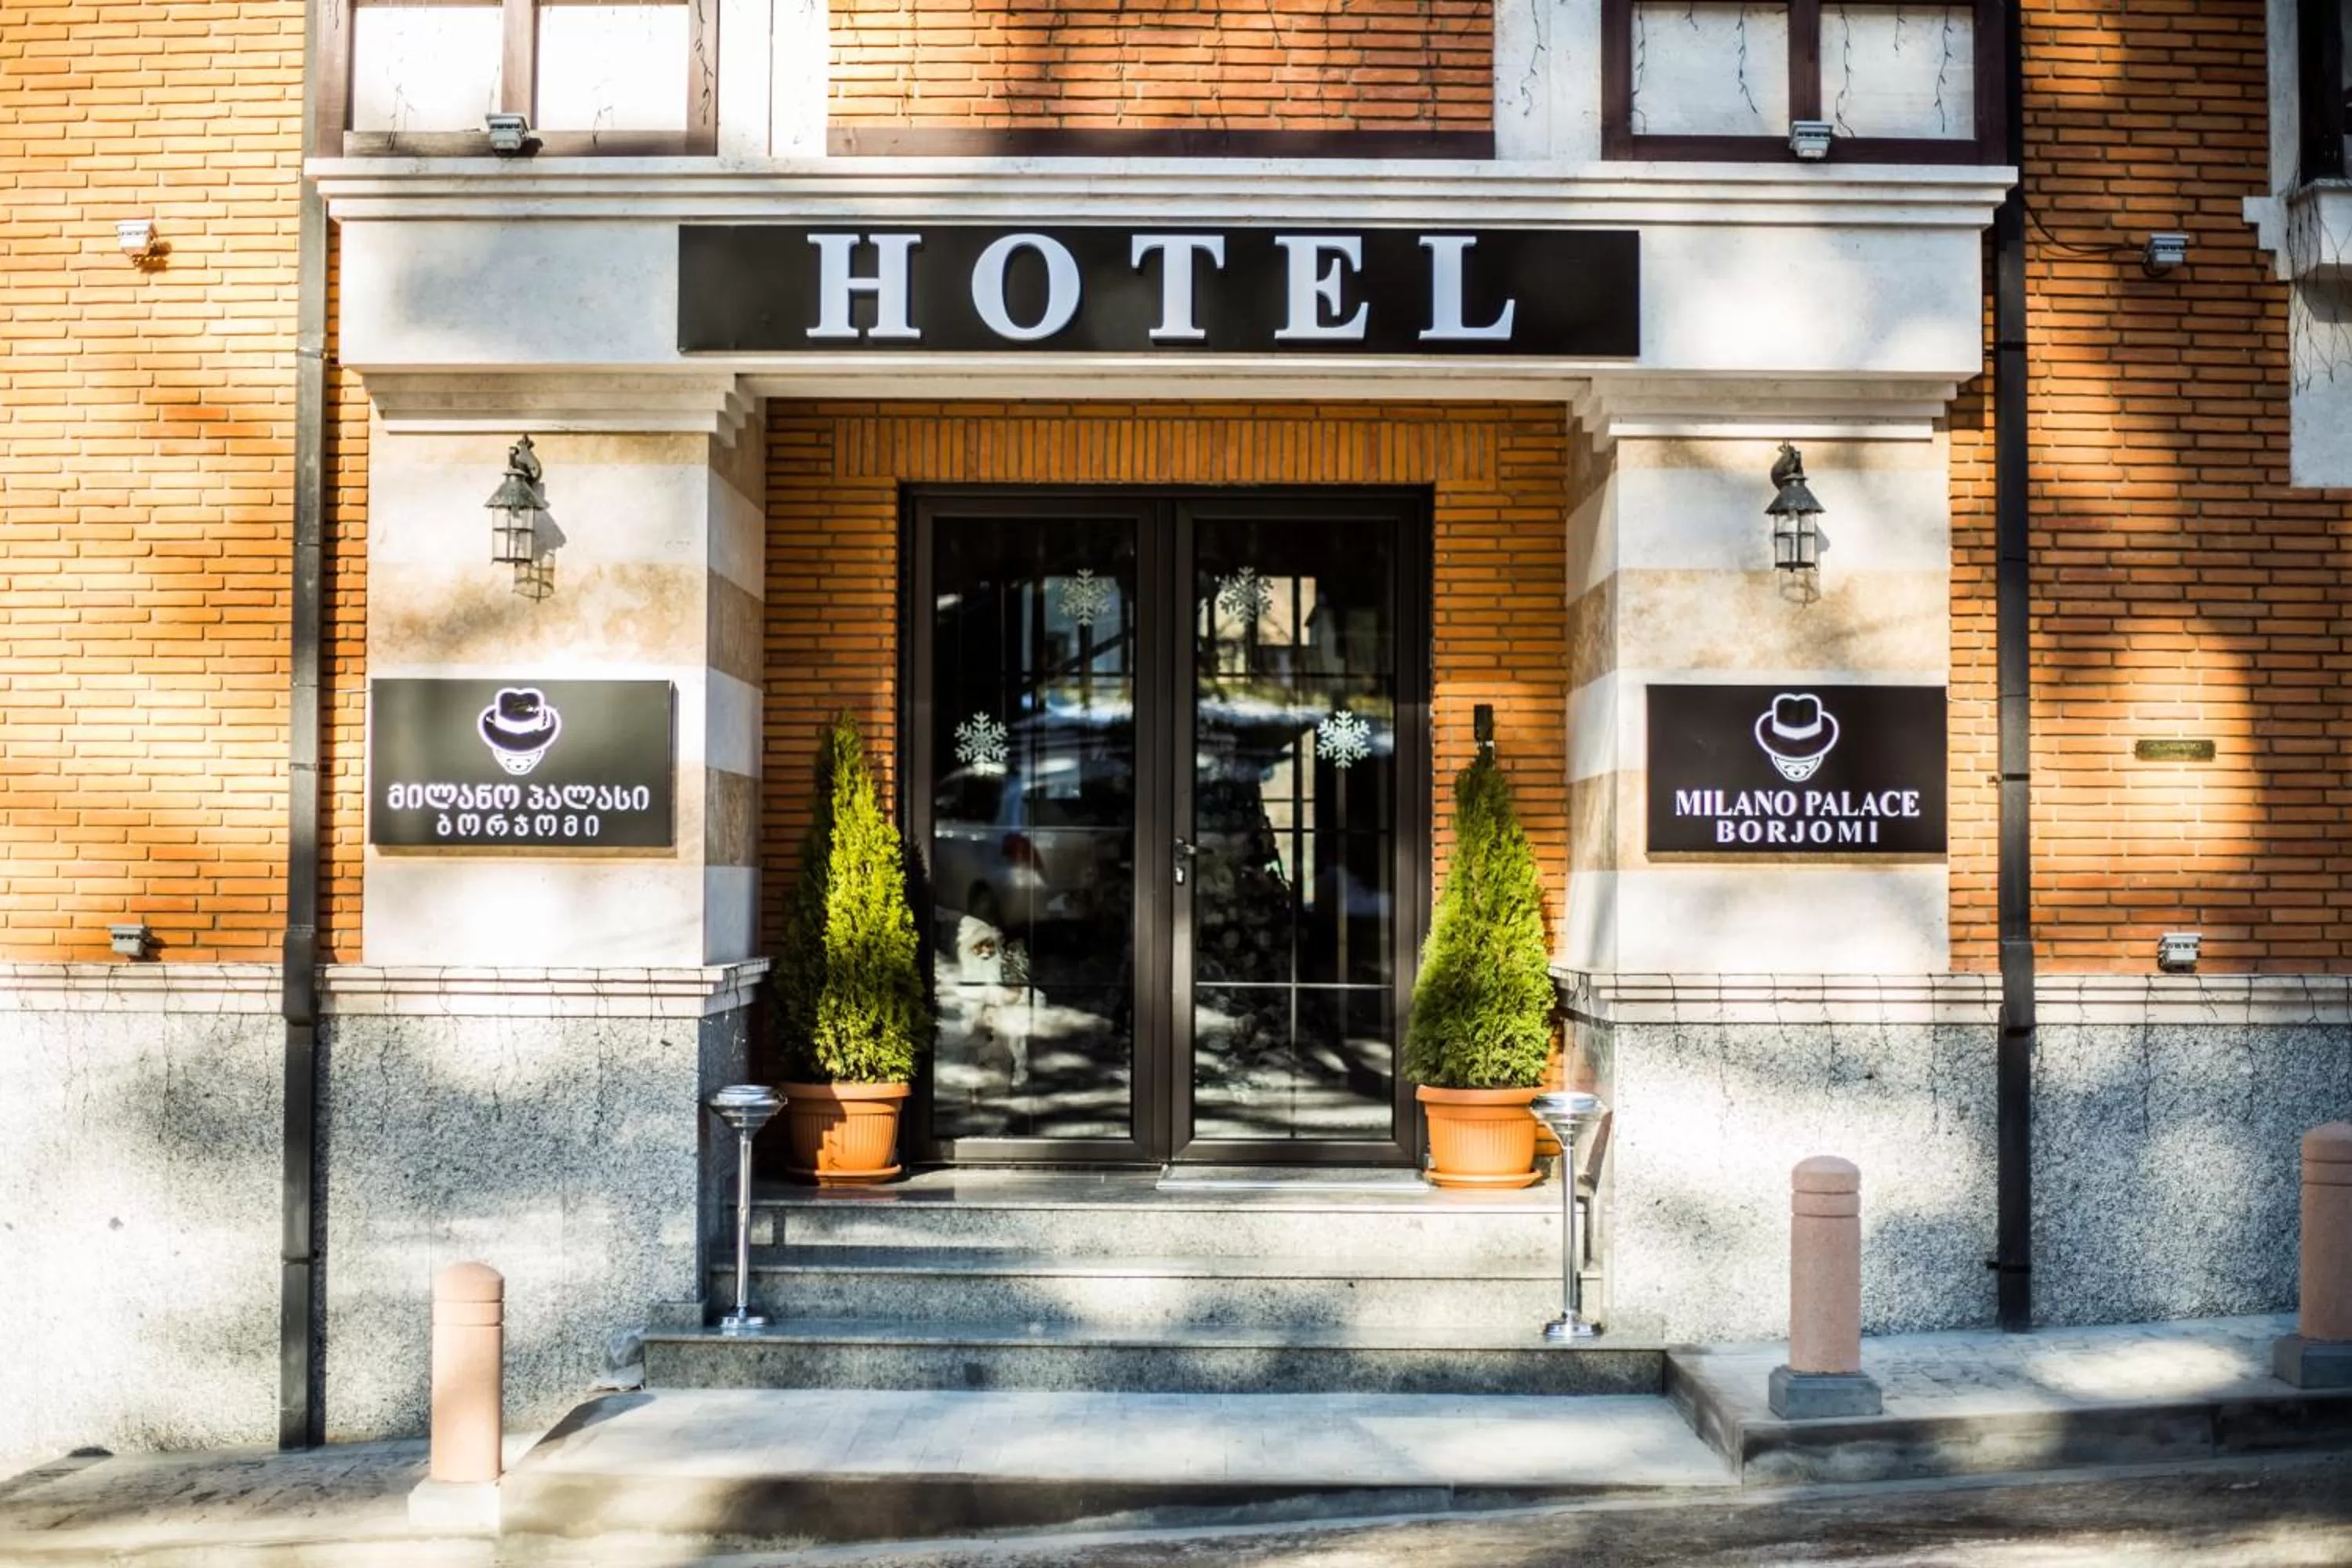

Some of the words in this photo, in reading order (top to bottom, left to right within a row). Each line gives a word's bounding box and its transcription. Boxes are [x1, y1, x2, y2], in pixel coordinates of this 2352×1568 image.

[806, 232, 1516, 342] HOTEL
[387, 783, 521, 811] მილანო
[526, 784, 650, 811] პალასი
[1675, 789, 1799, 818] MILANO
[1804, 790, 1921, 818] PALACE
[436, 813, 600, 837] ბორჯომი
[1716, 820, 1879, 844] BORJOMI
